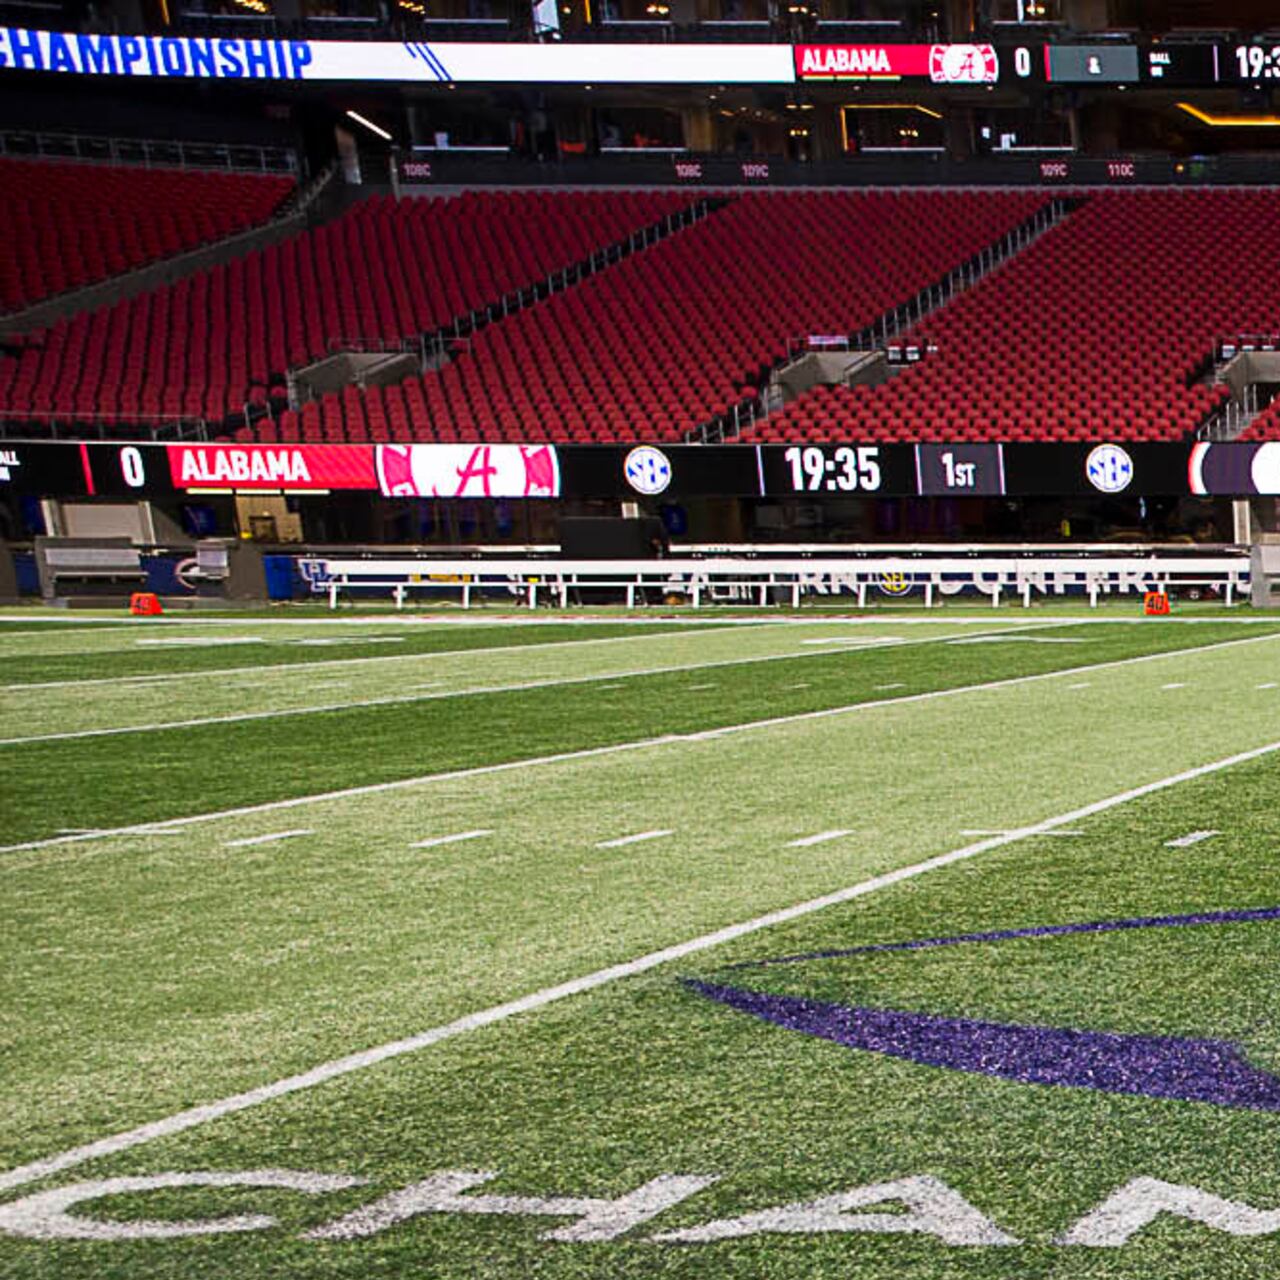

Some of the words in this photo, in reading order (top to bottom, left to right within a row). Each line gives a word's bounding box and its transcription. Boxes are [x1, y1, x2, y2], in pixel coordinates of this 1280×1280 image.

[0, 28, 312, 79] HAMPIONSHIP
[802, 48, 892, 72] ALABAMA
[1015, 47, 1031, 77] 0
[1108, 164, 1134, 176] 110C
[120, 446, 145, 487] 0
[182, 450, 311, 481] ALABAMA
[785, 446, 881, 491] 19:35
[941, 452, 976, 487] 1ST
